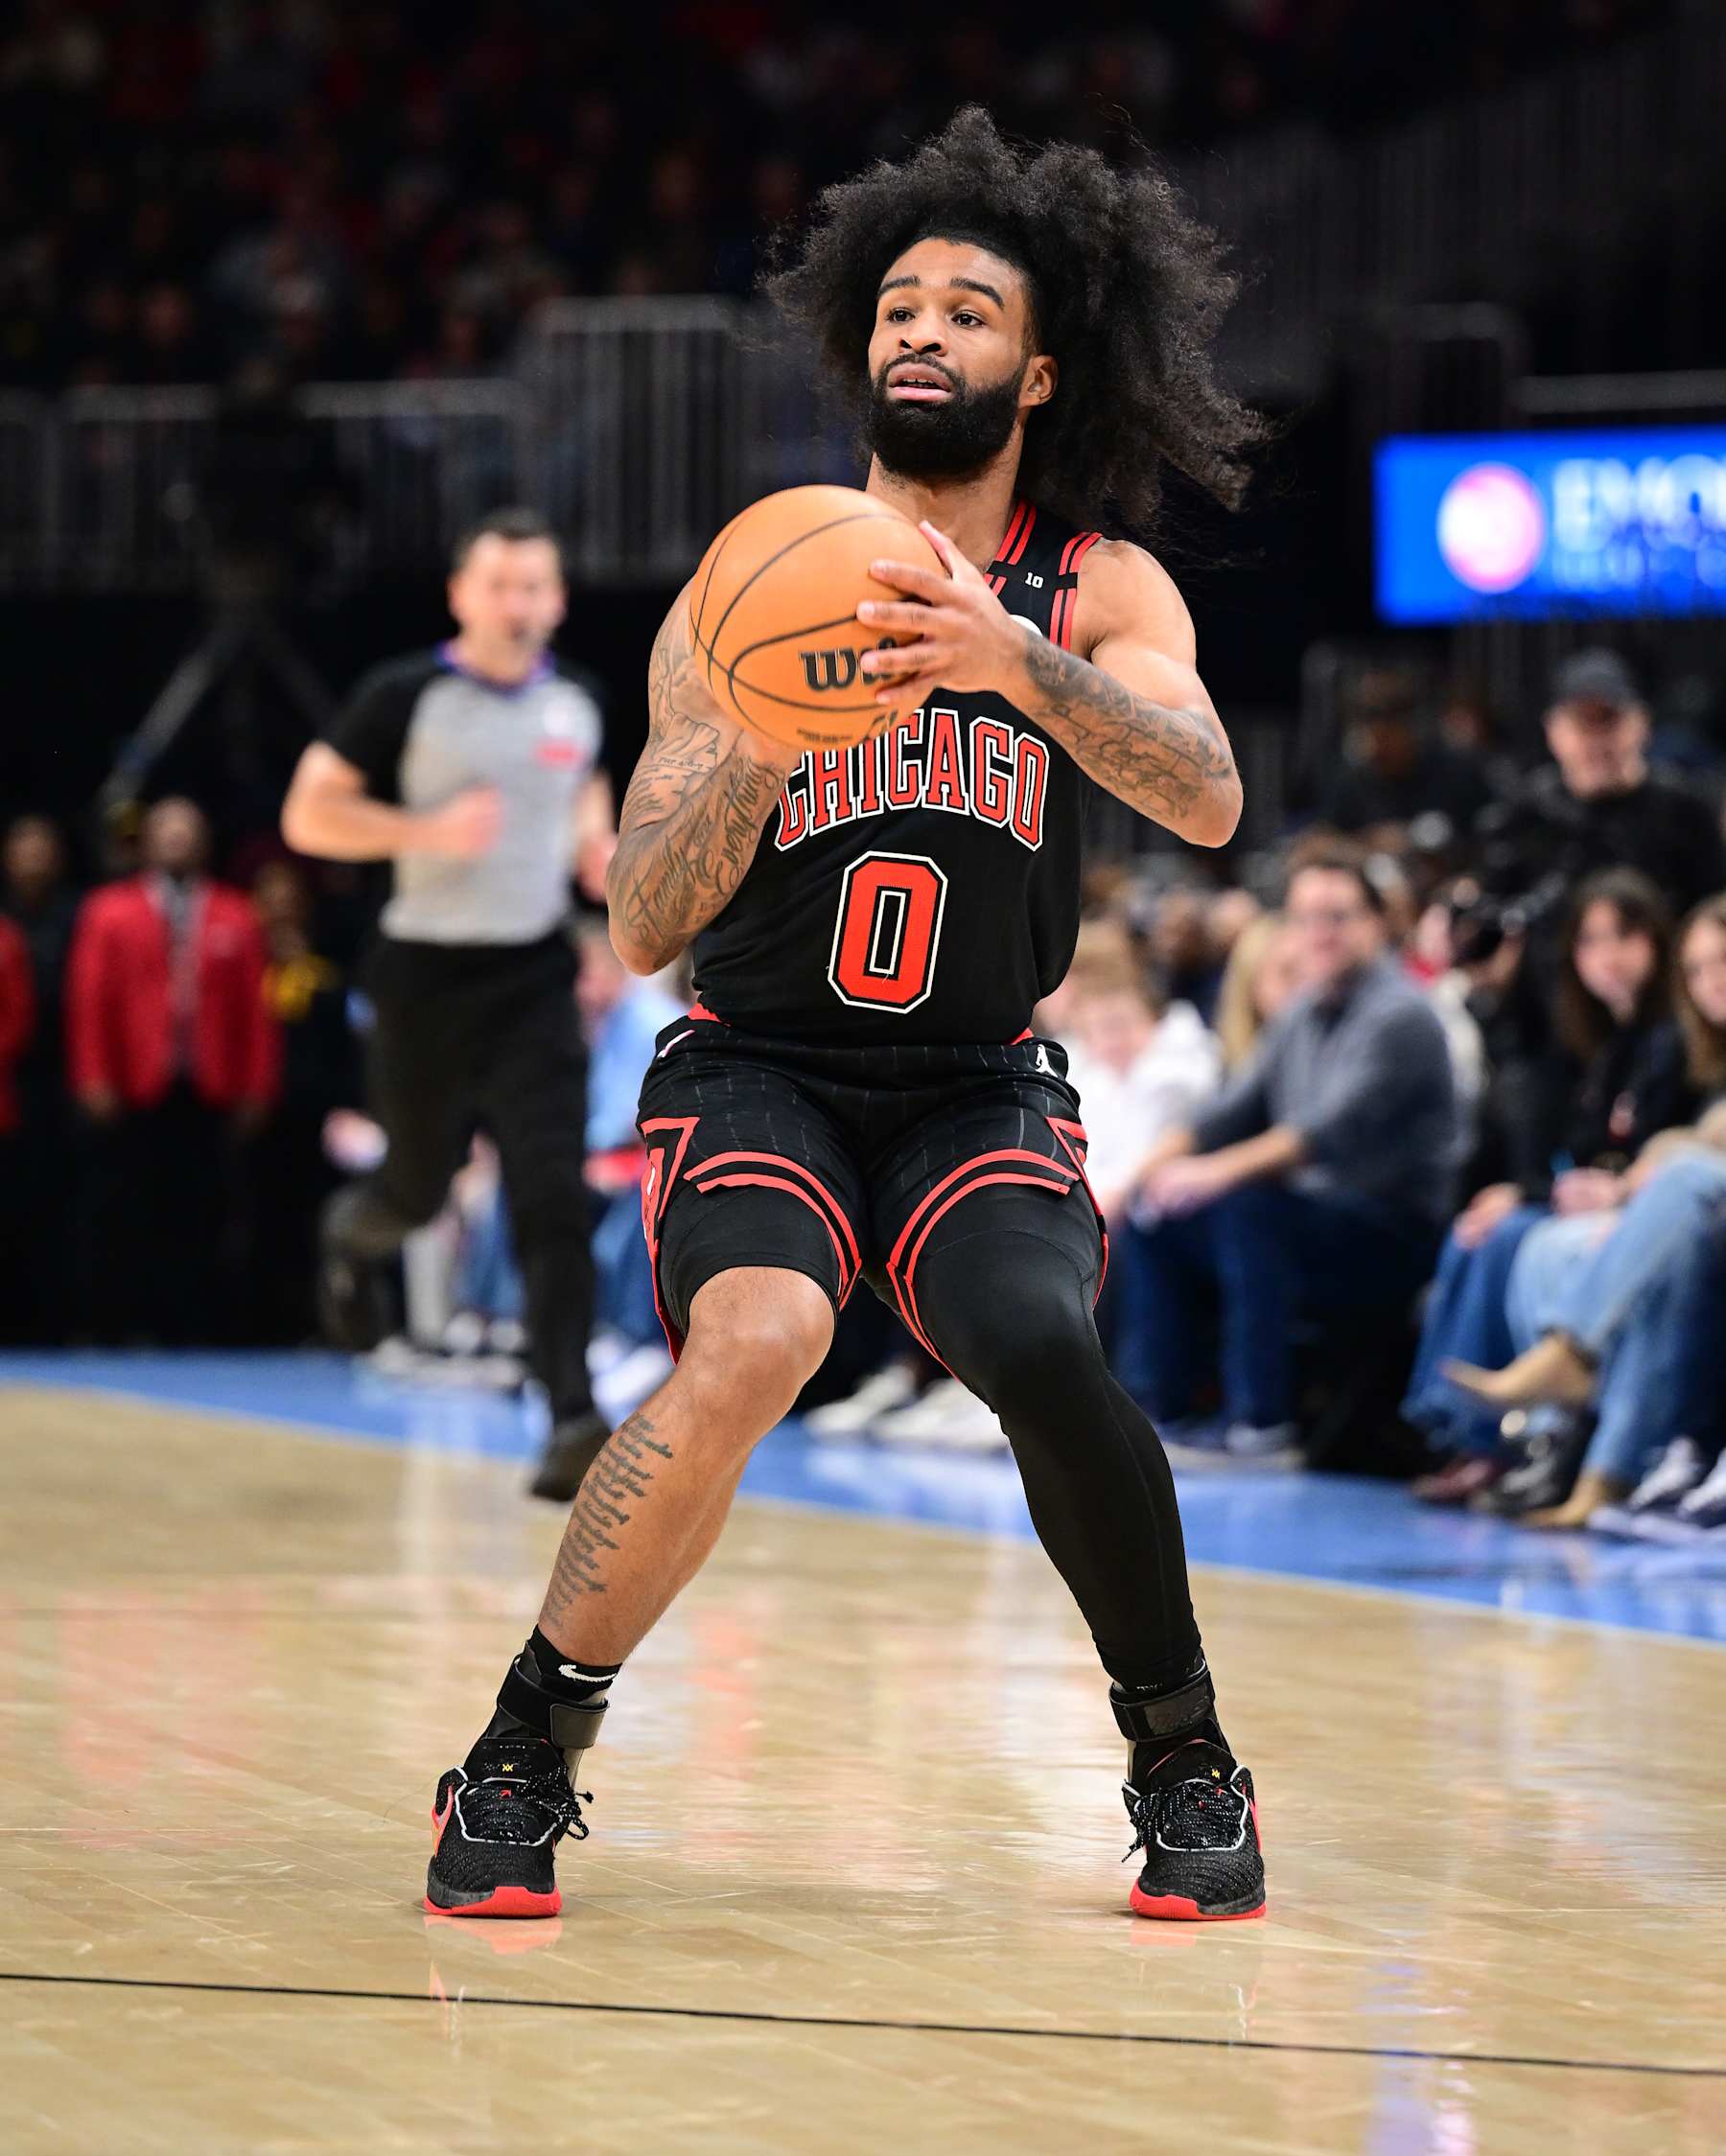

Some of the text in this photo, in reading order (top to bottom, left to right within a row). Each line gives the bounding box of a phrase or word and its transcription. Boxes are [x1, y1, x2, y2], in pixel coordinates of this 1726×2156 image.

[1024, 571, 1044, 589] 10
[774, 707, 1049, 851] CHICAGO
[828, 850, 948, 1014] 0
